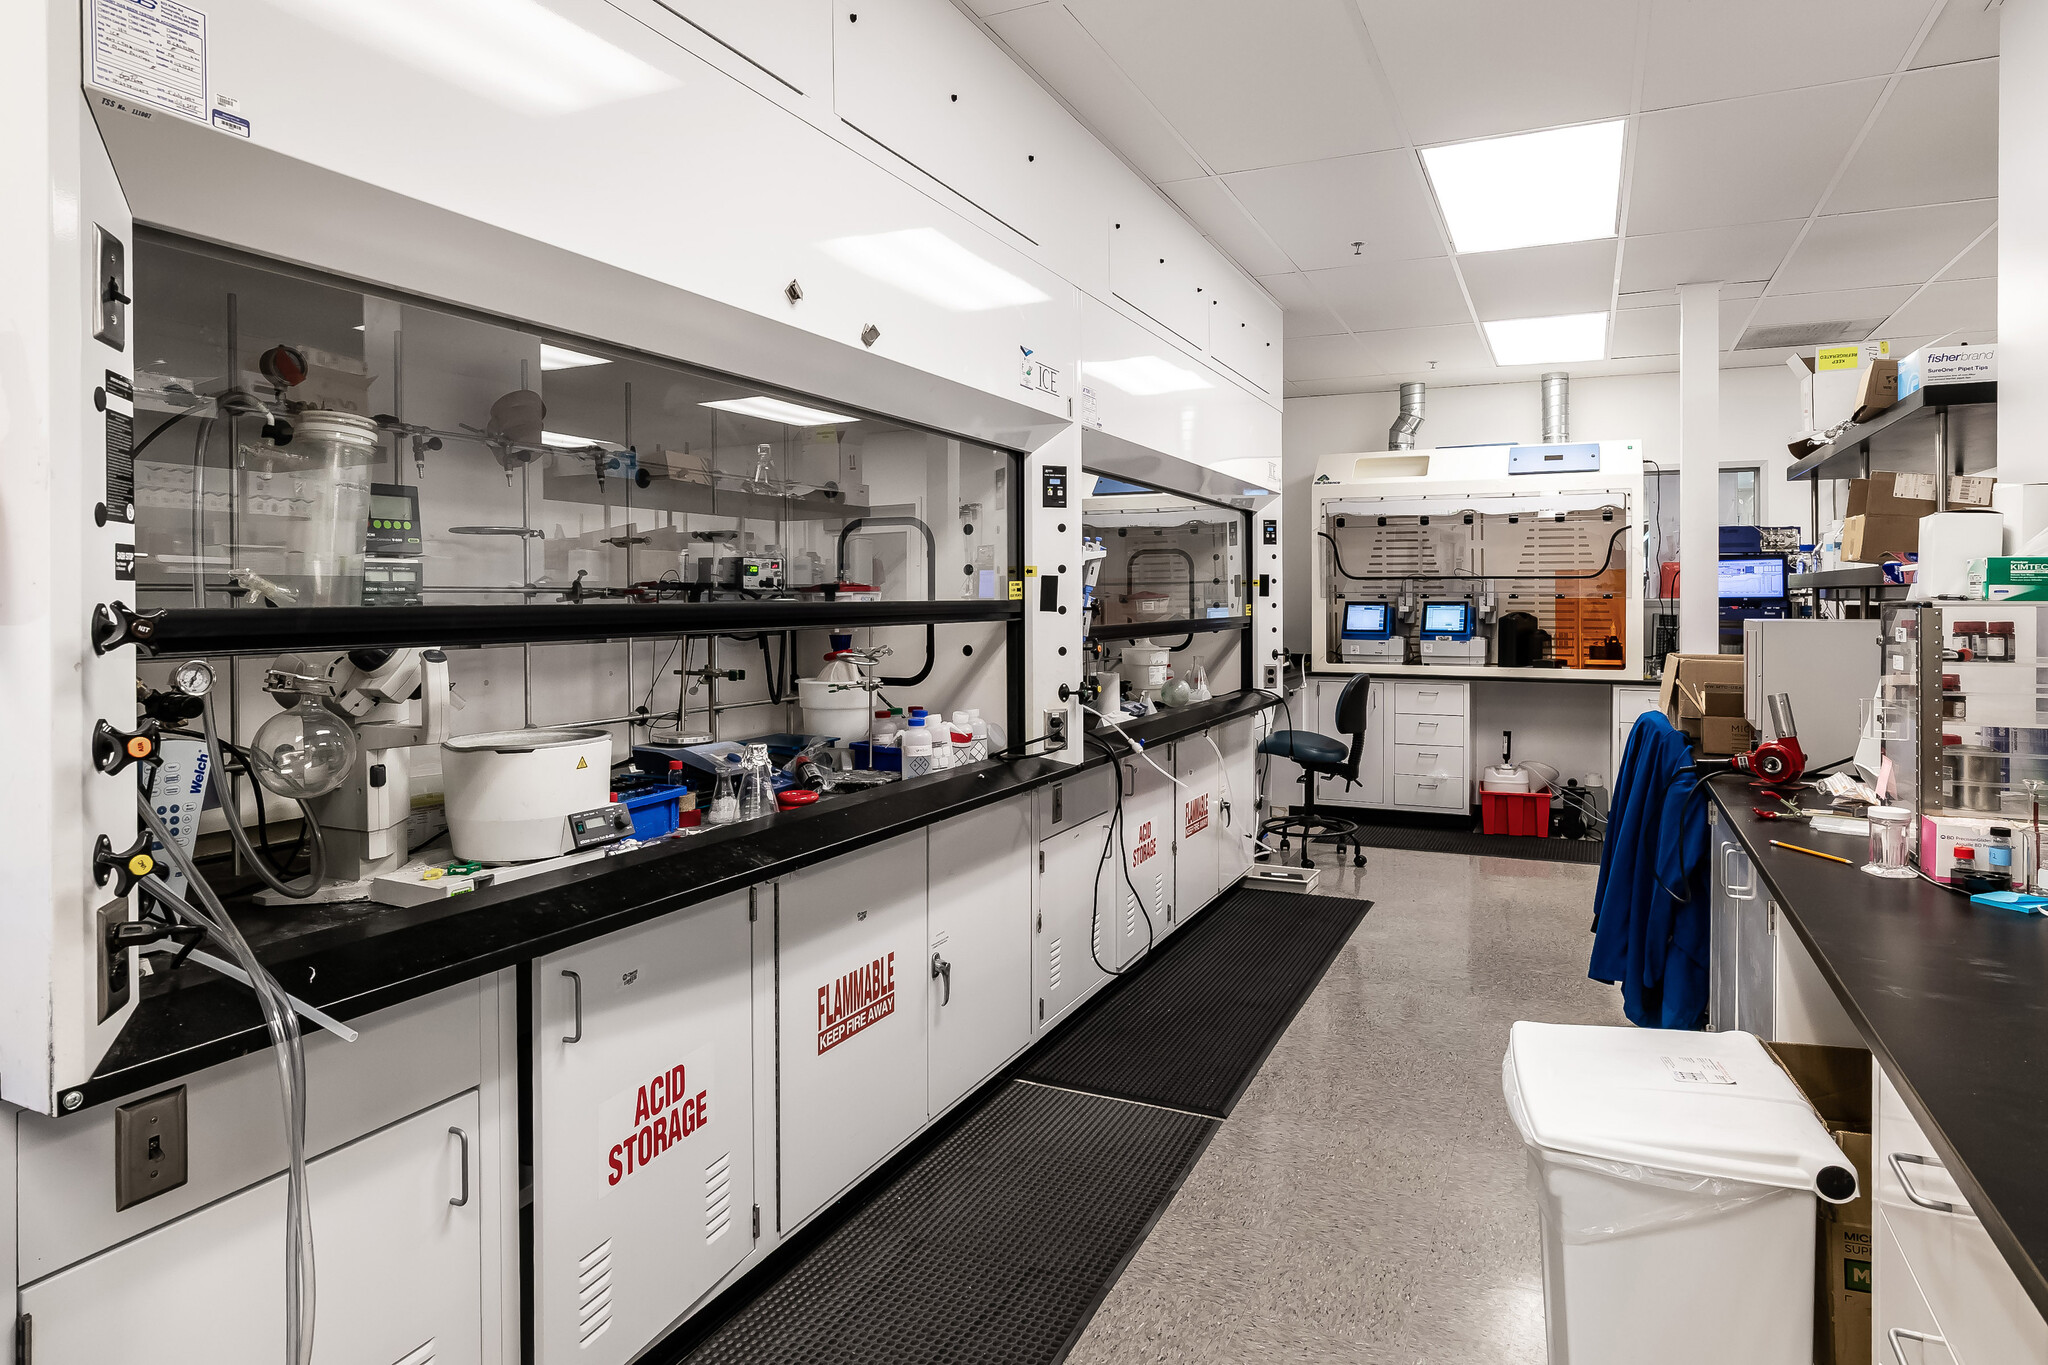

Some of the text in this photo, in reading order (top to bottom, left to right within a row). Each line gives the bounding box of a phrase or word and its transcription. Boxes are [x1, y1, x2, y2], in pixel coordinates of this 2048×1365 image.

[1928, 350, 1994, 363] fisherbrand
[1039, 366, 1058, 393] ICE
[190, 754, 208, 794] Welch
[1139, 821, 1151, 844] ACID
[1132, 838, 1156, 868] STORAGE
[818, 952, 894, 1032] FLAMMABLE
[819, 996, 894, 1050] KEEP FIRE AWAY
[634, 1064, 685, 1128] ACID
[609, 1090, 707, 1186] STORAGE
